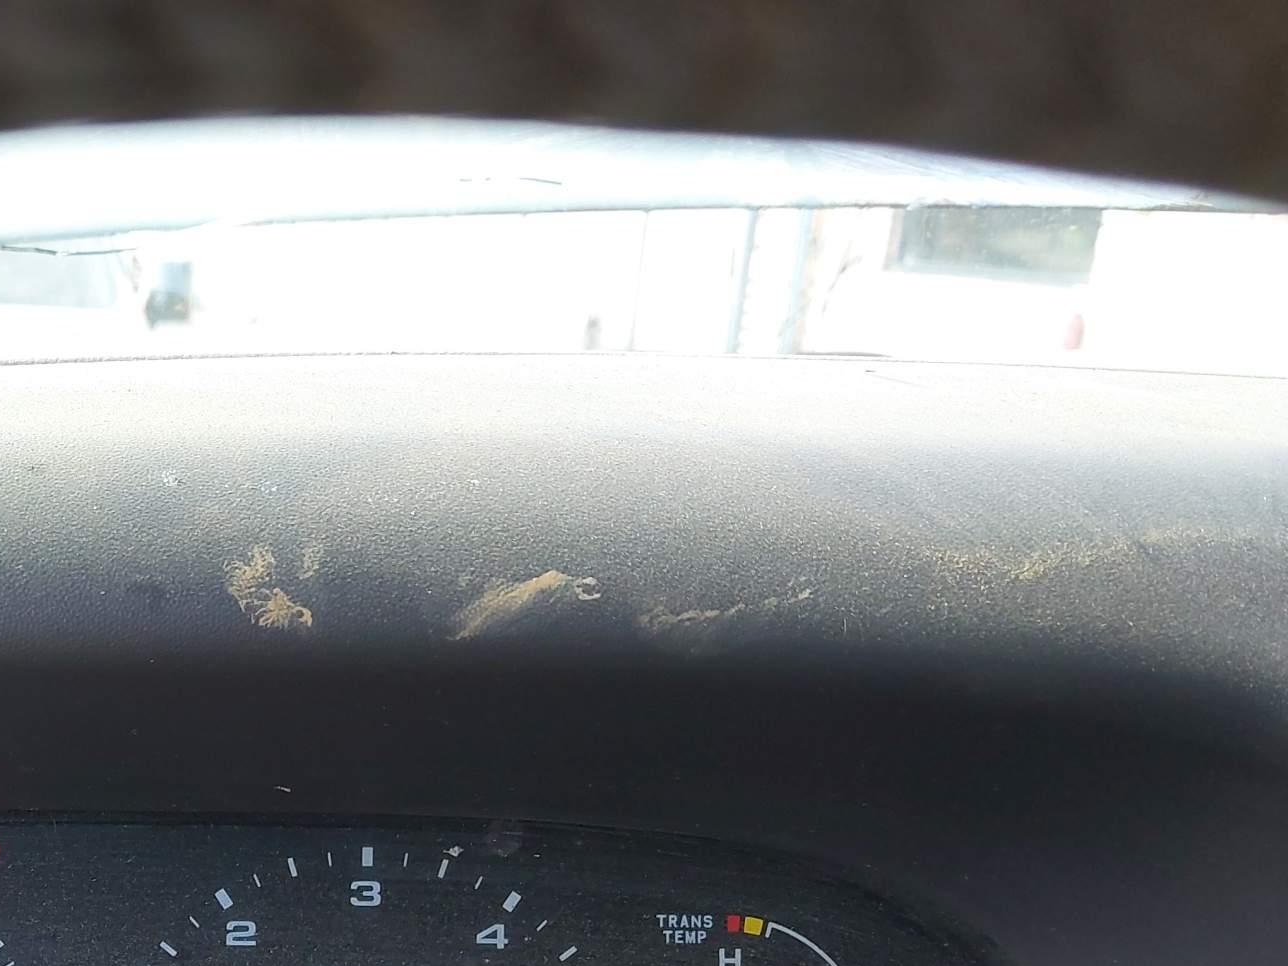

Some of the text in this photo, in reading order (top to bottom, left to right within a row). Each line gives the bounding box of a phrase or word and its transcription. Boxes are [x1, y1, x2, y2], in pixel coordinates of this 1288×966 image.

[350, 880, 382, 907] 3
[225, 920, 257, 946] 2
[656, 914, 713, 929] TRANS
[475, 924, 509, 949] 4
[663, 930, 707, 944] TEMP
